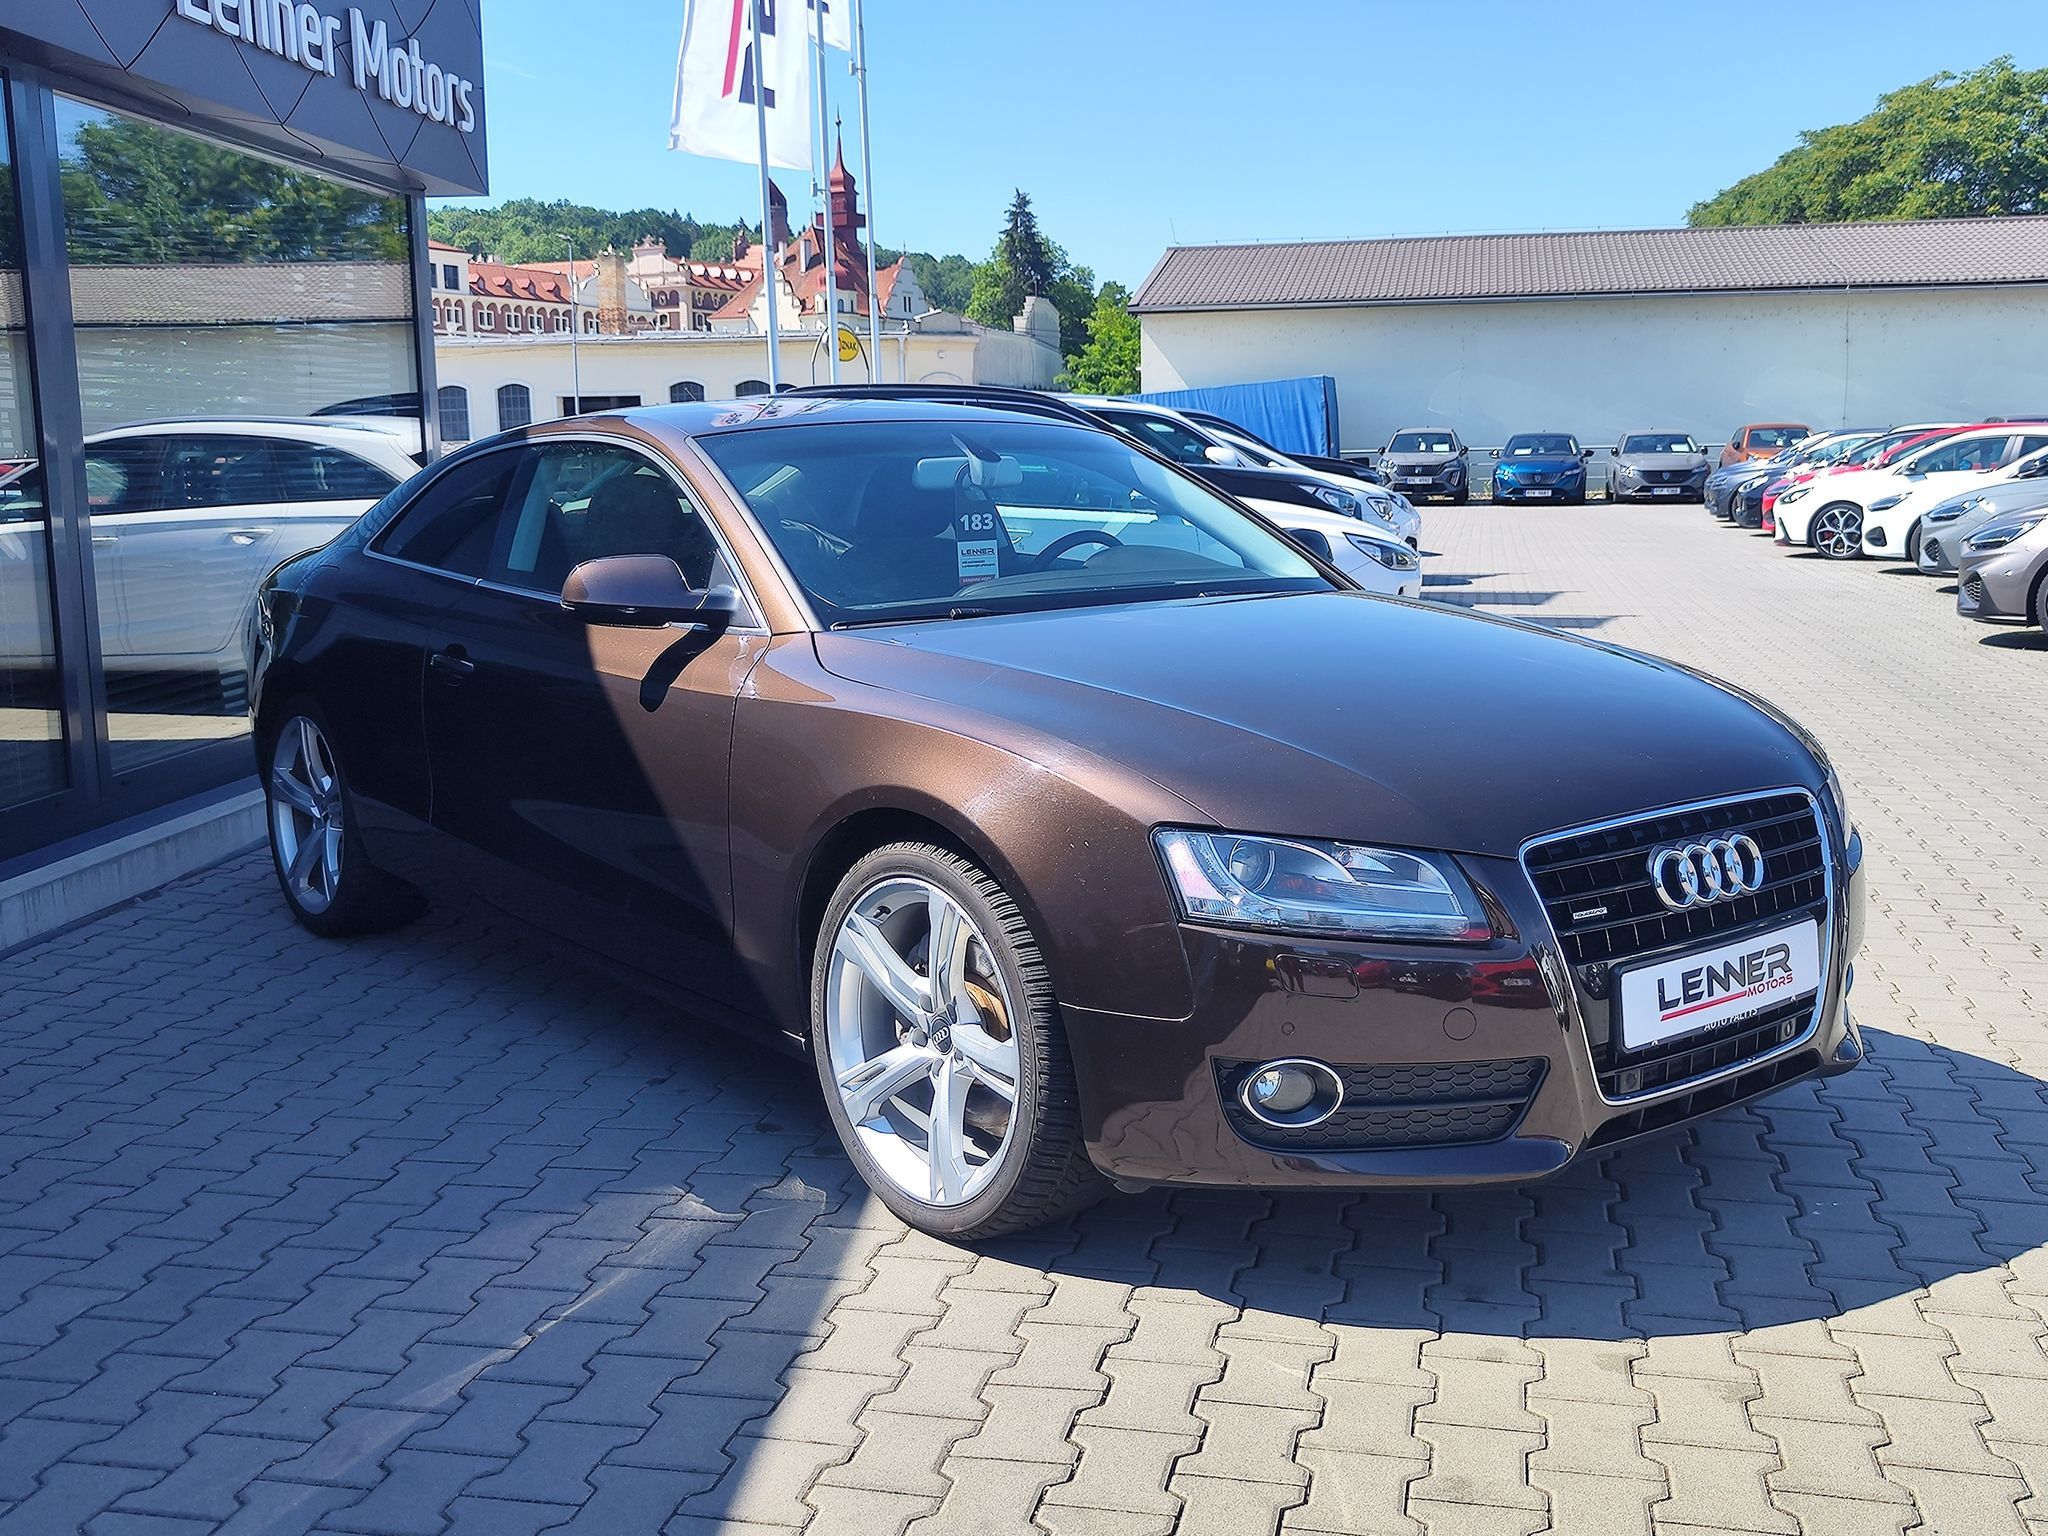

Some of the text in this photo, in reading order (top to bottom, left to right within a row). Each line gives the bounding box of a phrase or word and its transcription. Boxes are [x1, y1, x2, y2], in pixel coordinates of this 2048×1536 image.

[348, 7, 476, 133] Motors
[960, 513, 994, 531] 183
[961, 547, 996, 556] LENNER
[1657, 943, 1793, 1011] LENNER
[1747, 973, 1793, 997] MOTORS
